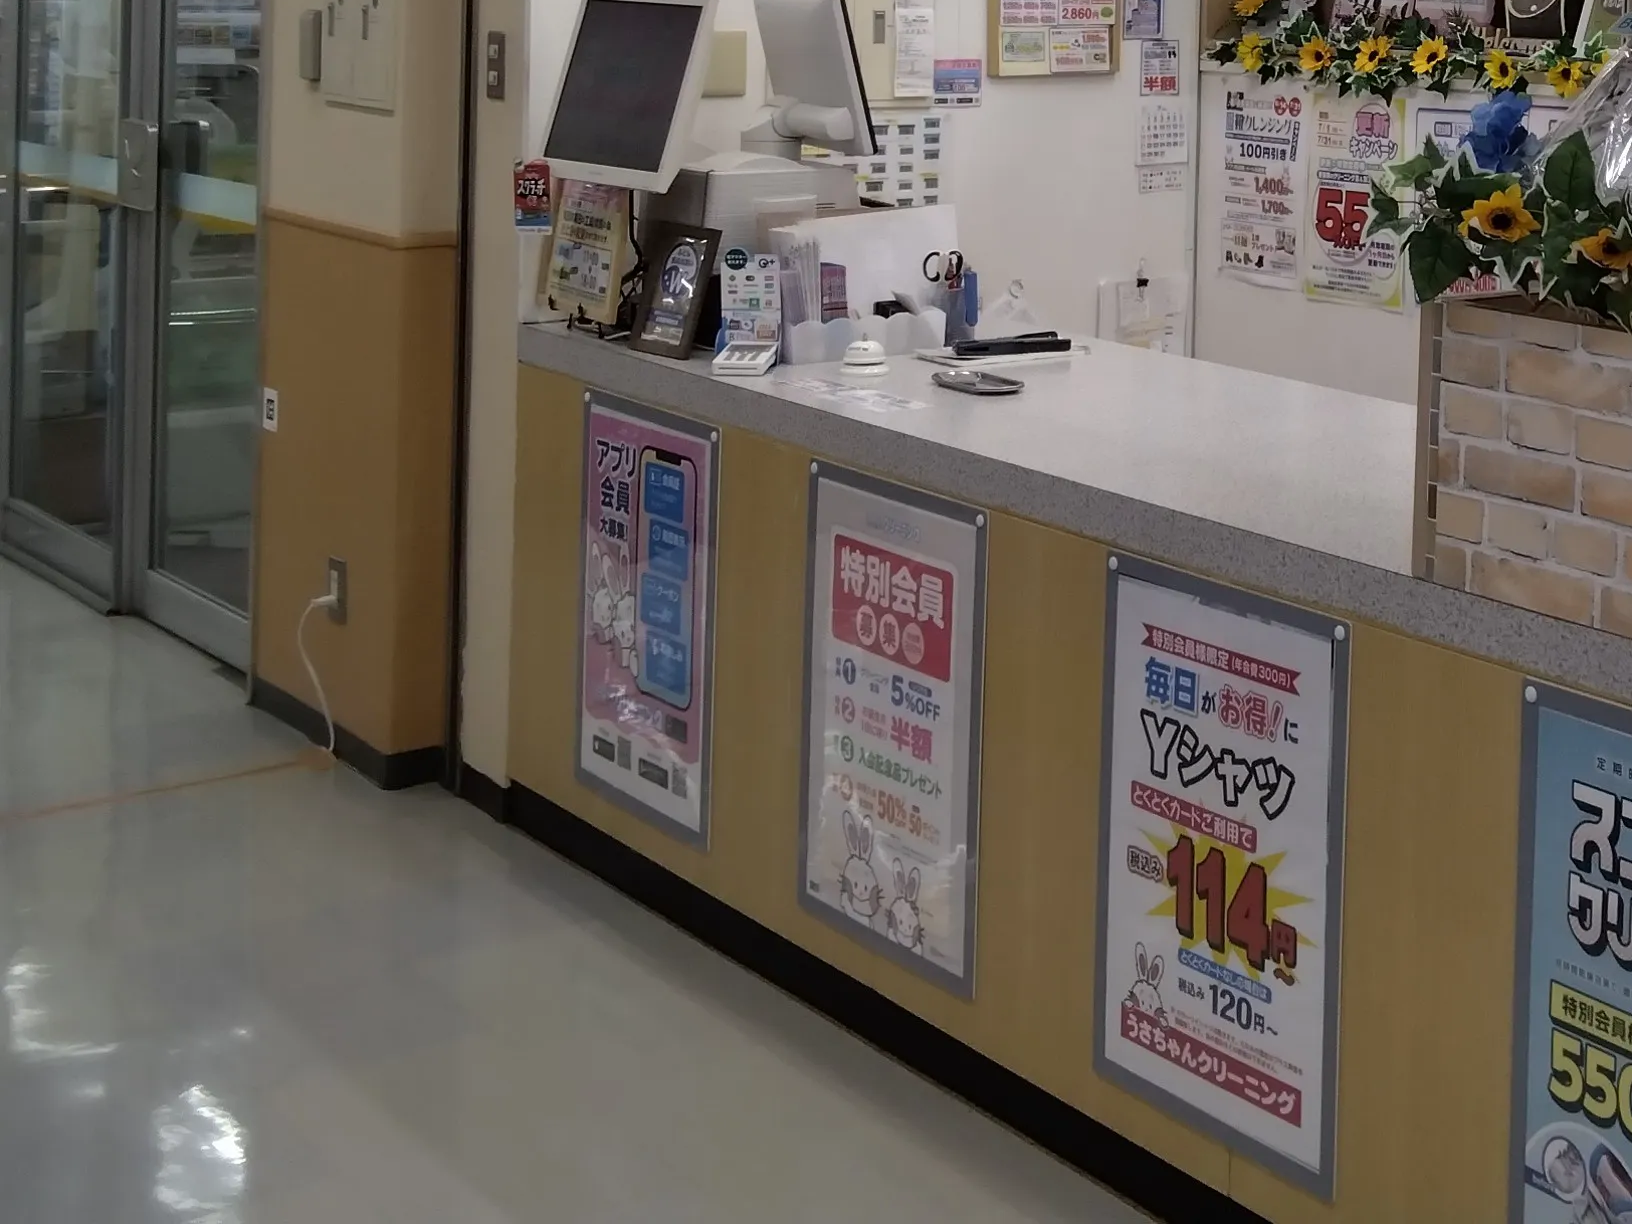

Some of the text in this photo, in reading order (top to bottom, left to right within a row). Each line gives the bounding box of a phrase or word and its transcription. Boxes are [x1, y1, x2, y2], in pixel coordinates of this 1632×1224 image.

[1350, 136, 1398, 160] キャンペーン
[1356, 111, 1390, 138] 更新
[1239, 142, 1287, 161] 100円引き
[1316, 187, 1370, 243] 55
[596, 439, 637, 477] アプリ
[601, 475, 630, 515] 会員
[841, 545, 945, 629] 特別会員
[859, 610, 898, 650] 募集
[1152, 628, 1291, 689] 特別会員様限定 (年会費300円)
[891, 675, 941, 722] 5%OFF
[890, 716, 933, 764] 半額
[1140, 708, 1295, 820] Yシャツ
[1132, 785, 1255, 848] とくとくカードご利用で
[1129, 849, 1163, 880] 税込み
[1126, 1012, 1297, 1116] うさちゃんクリーニング
